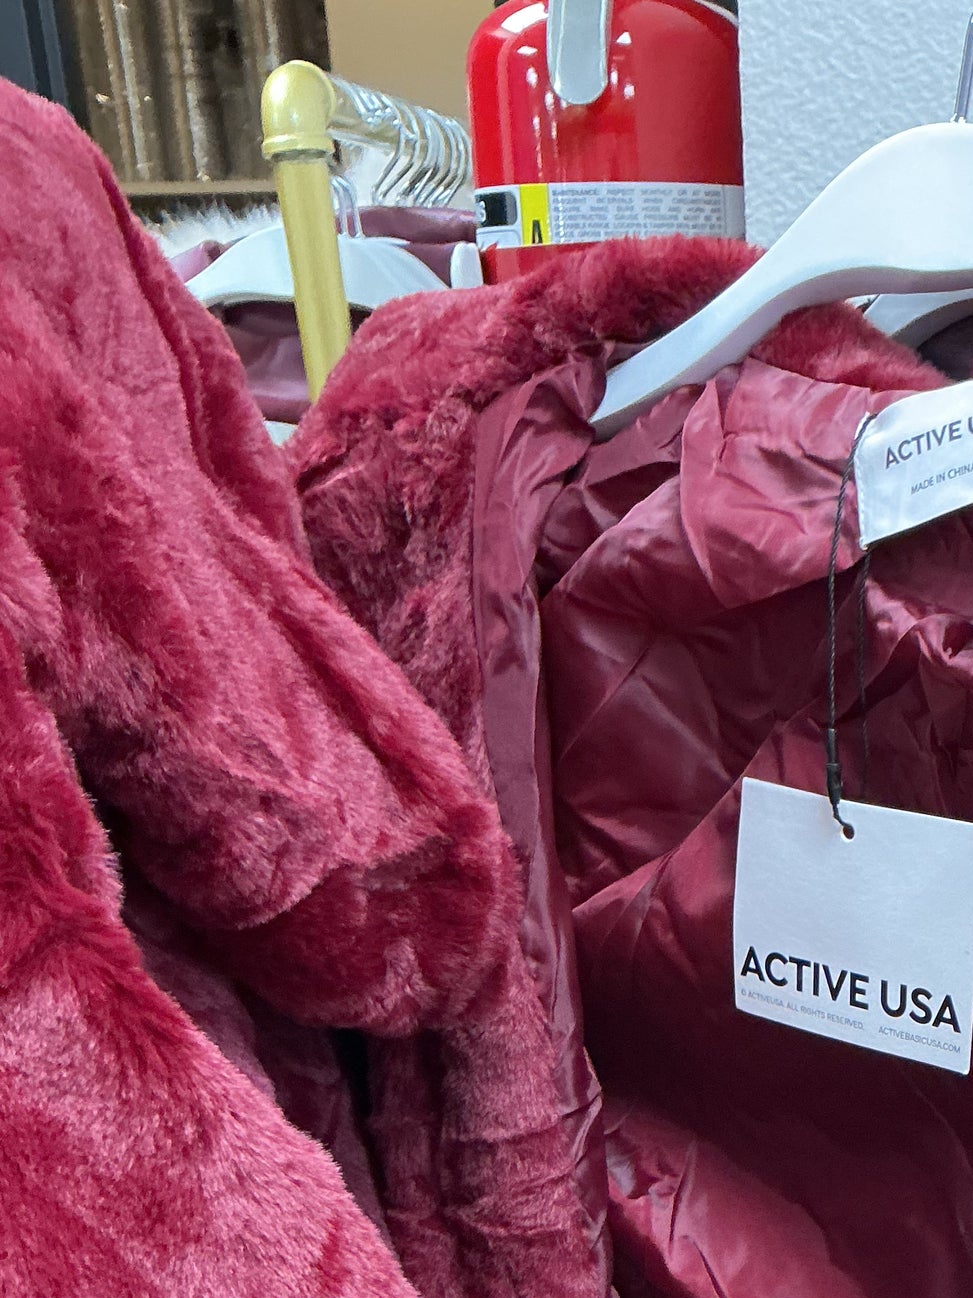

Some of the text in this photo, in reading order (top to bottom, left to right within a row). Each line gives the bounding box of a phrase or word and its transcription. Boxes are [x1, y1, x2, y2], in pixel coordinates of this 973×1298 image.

[885, 419, 963, 469] ACTIVE
[910, 476, 935, 495] MADE
[936, 471, 946, 484] IN
[740, 945, 962, 1034] ACTIVE USA
[786, 1002, 799, 1013] ALL
[800, 1005, 826, 1020] RIGHTS
[878, 1026, 961, 1054] ACTIVEBASICUSA.COM
